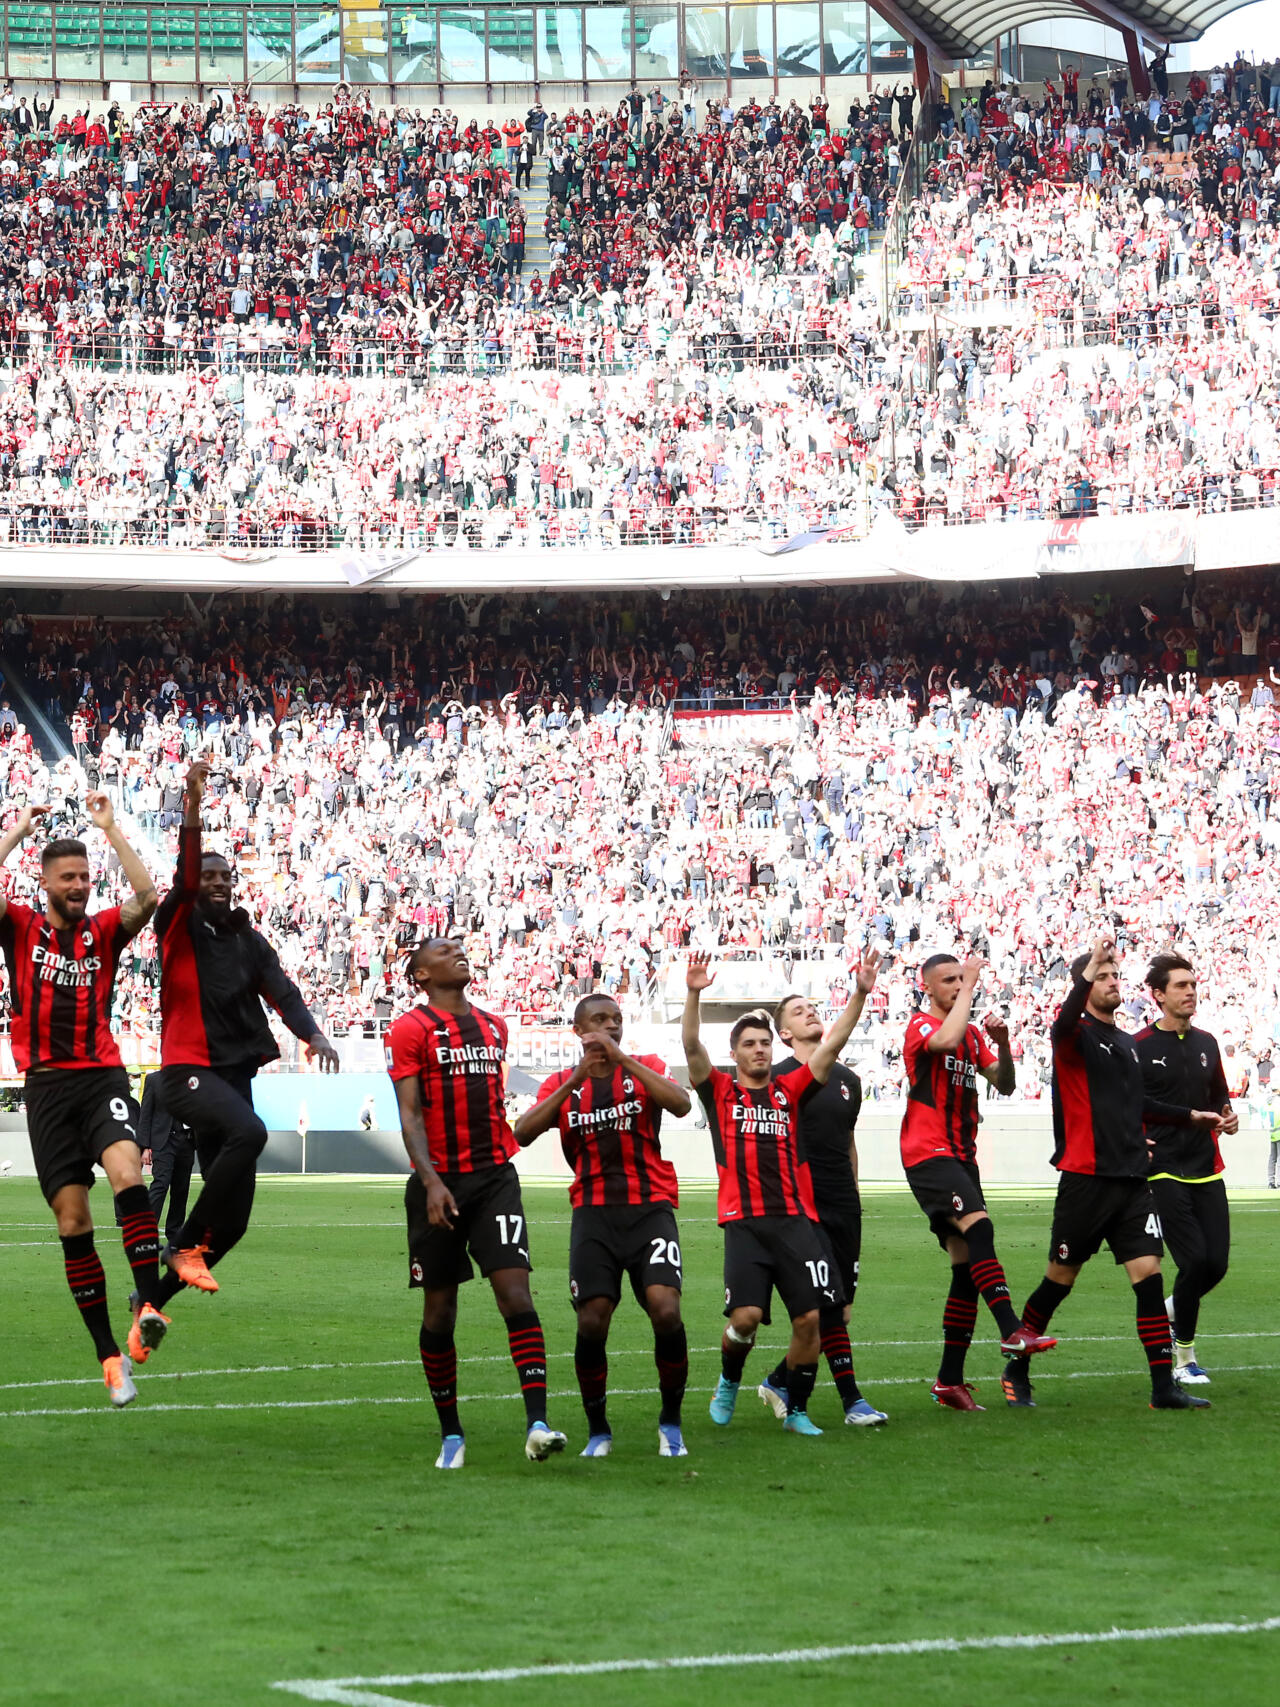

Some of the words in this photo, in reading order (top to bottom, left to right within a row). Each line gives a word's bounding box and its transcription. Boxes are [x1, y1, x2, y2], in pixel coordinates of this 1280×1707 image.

[32, 944, 101, 973] Emirates
[39, 965, 57, 982] FLY
[56, 970, 92, 986] BETTER
[435, 1044, 504, 1064] Emirate
[109, 1097, 129, 1122] 9
[567, 1100, 643, 1128] Emirates
[732, 1105, 790, 1124] Emirates
[741, 1121, 758, 1133] FLY
[495, 1214, 523, 1245] 17
[135, 1243, 157, 1253] ACM
[649, 1237, 681, 1268] 20
[805, 1259, 829, 1288] 10
